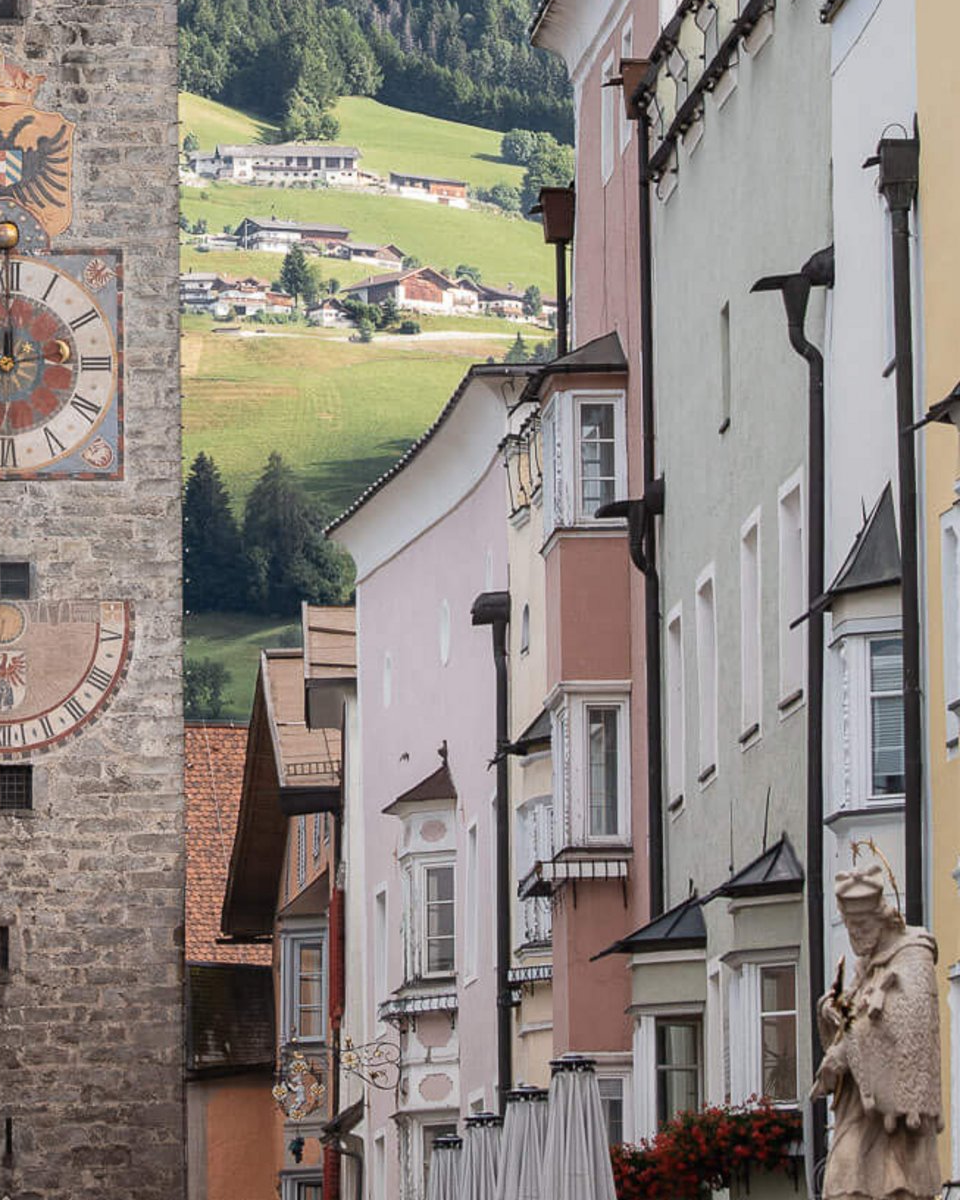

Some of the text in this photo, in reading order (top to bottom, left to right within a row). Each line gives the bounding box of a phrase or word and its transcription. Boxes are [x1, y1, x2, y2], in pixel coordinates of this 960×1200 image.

[42, 274, 59, 301] I
[69, 309, 100, 331] II
[81, 356, 111, 372] III
[0, 437, 17, 467] VI
[43, 427, 67, 457] V
[100, 629, 123, 643] V
